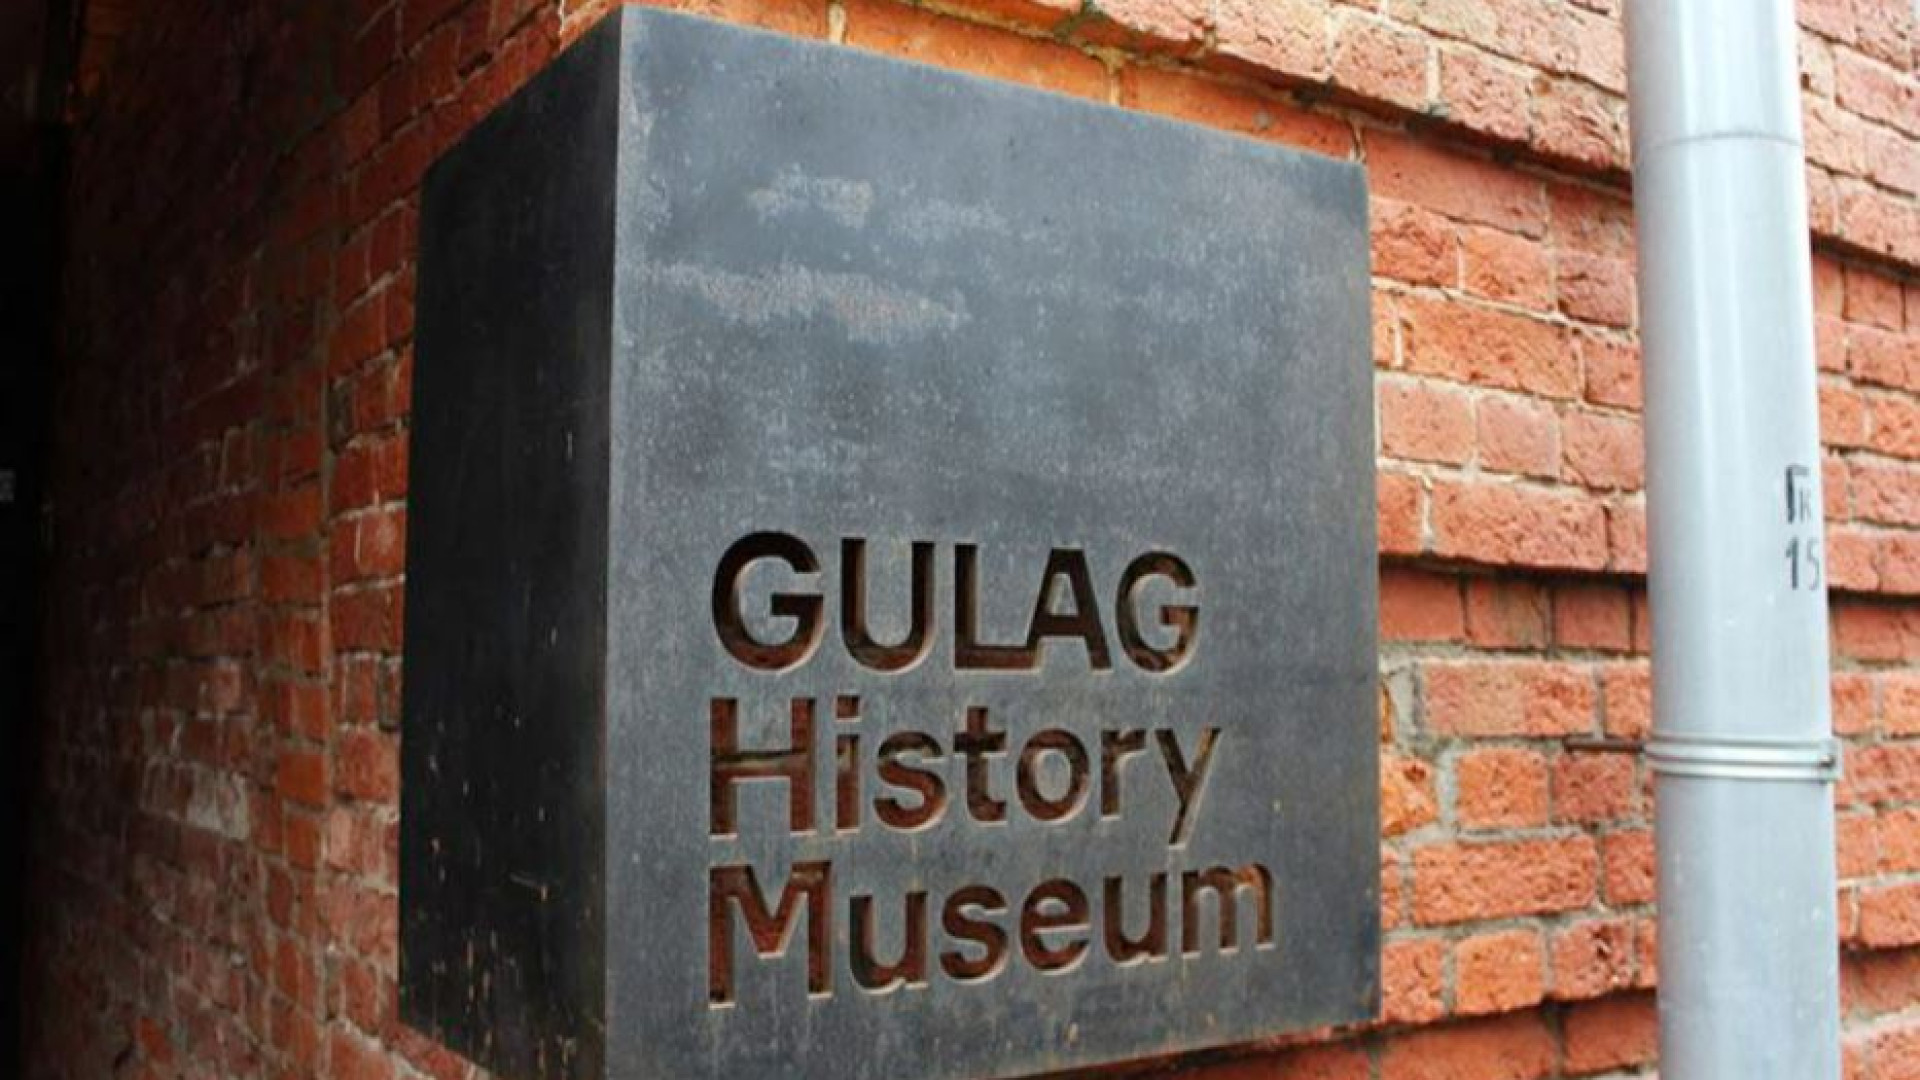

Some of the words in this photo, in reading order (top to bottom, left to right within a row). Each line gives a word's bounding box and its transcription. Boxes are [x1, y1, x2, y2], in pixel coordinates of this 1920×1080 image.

[711, 530, 1199, 673] GULAG
[1785, 535, 1821, 590] 15
[709, 695, 1221, 849] History
[709, 859, 1275, 1010] Museum
